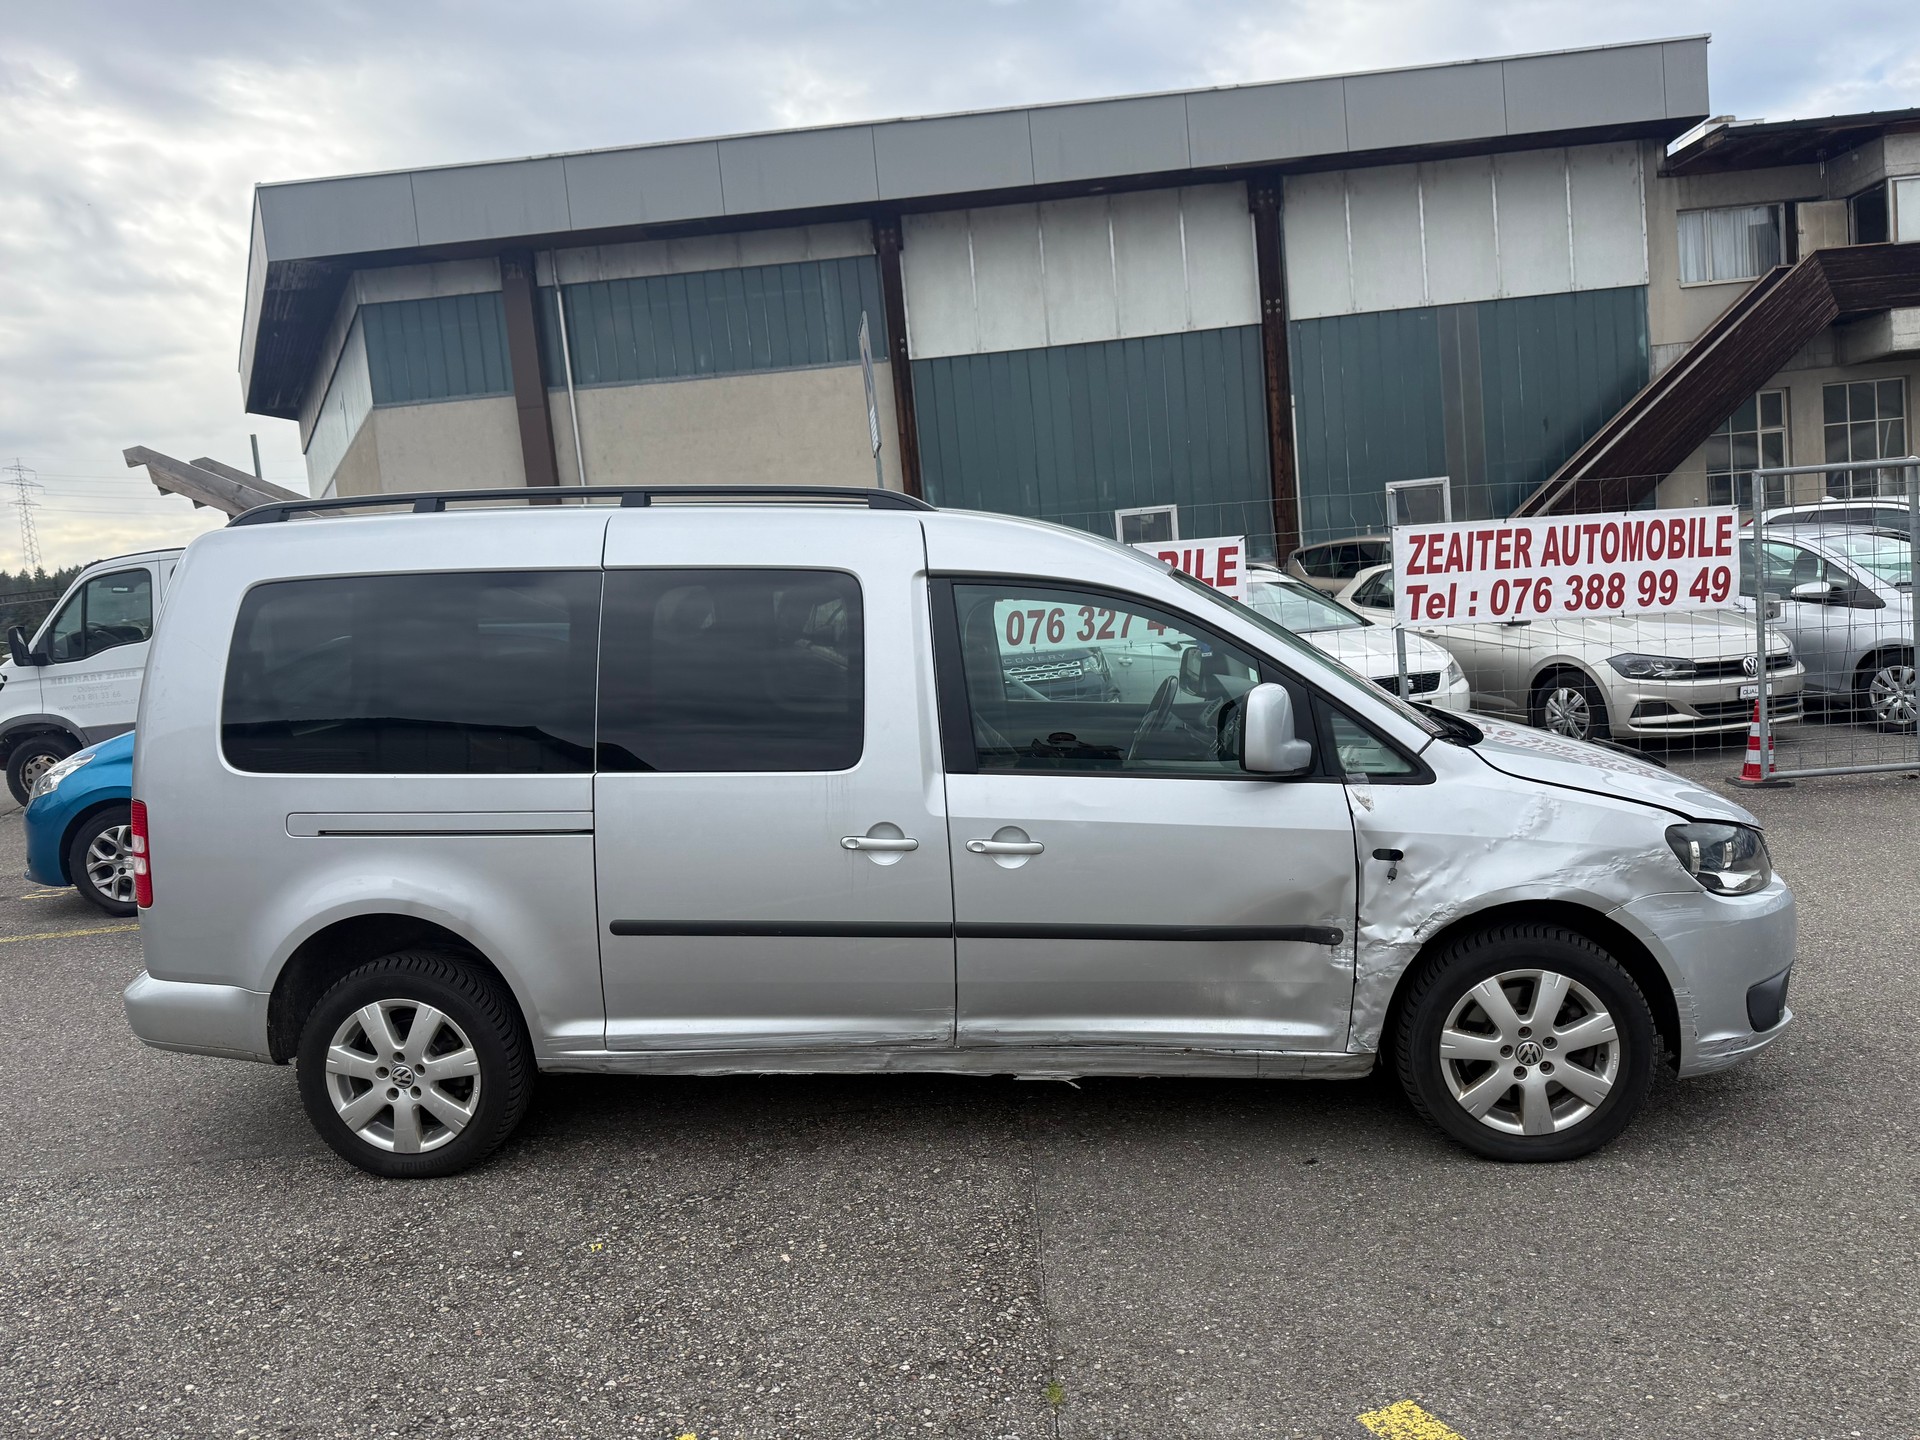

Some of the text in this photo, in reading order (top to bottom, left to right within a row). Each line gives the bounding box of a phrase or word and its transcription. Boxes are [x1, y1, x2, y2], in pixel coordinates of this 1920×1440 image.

[1406, 515, 1733, 576] ZEAITER AUTOMOBILE
[1406, 582, 1457, 621] Tel
[1489, 576, 1553, 616] 076
[1563, 572, 1627, 611] 388
[1637, 568, 1679, 607] 99
[1689, 565, 1732, 603] 49
[1006, 607, 1065, 646] 076
[1076, 606, 1133, 642] 327
[1003, 653, 1066, 665] COVERY
